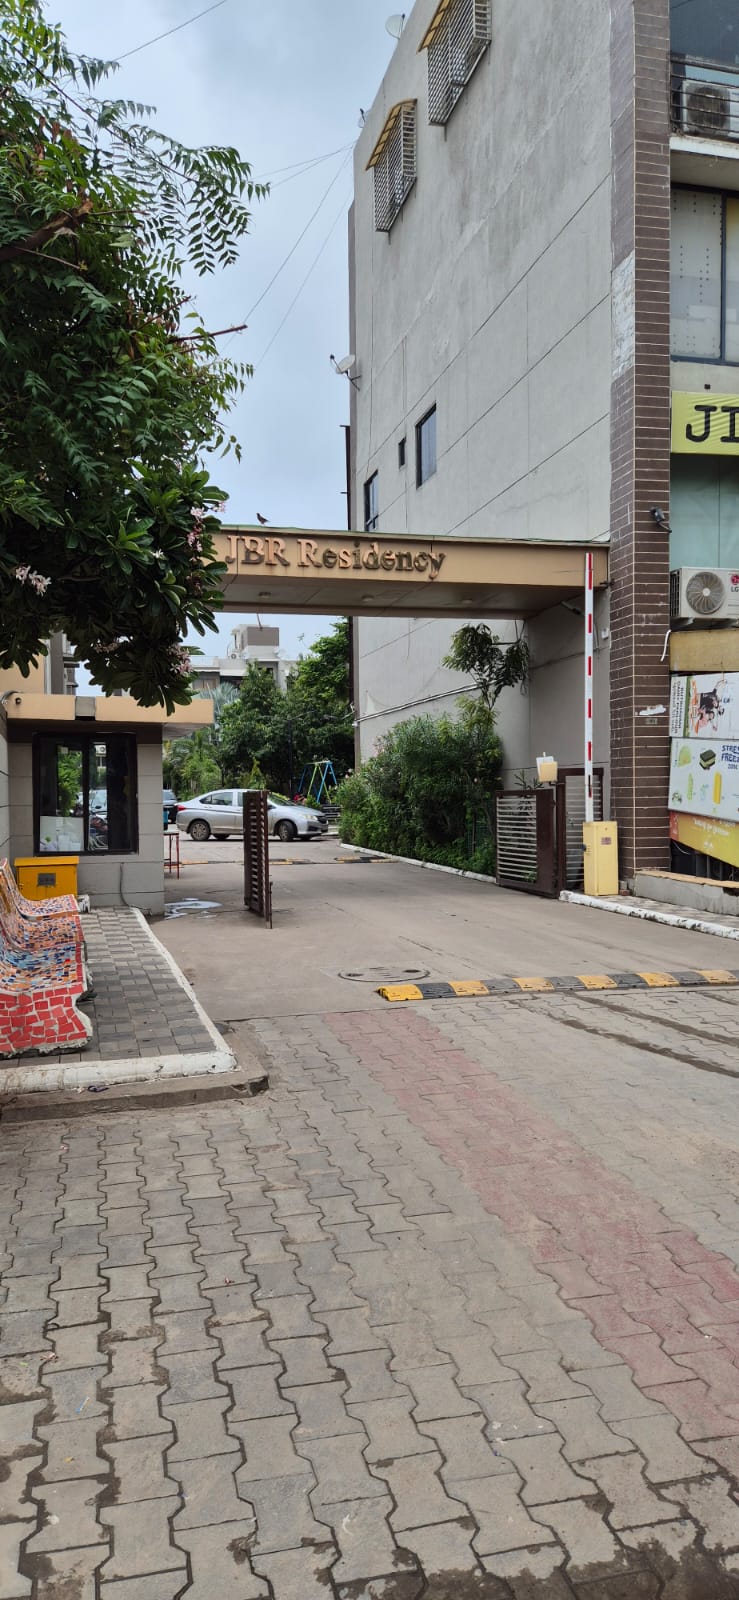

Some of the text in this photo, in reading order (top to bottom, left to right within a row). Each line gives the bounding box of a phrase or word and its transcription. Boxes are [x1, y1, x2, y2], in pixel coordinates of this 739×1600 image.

[225, 534, 447, 580] JBR Residency
[722, 745, 739, 754] STRE
